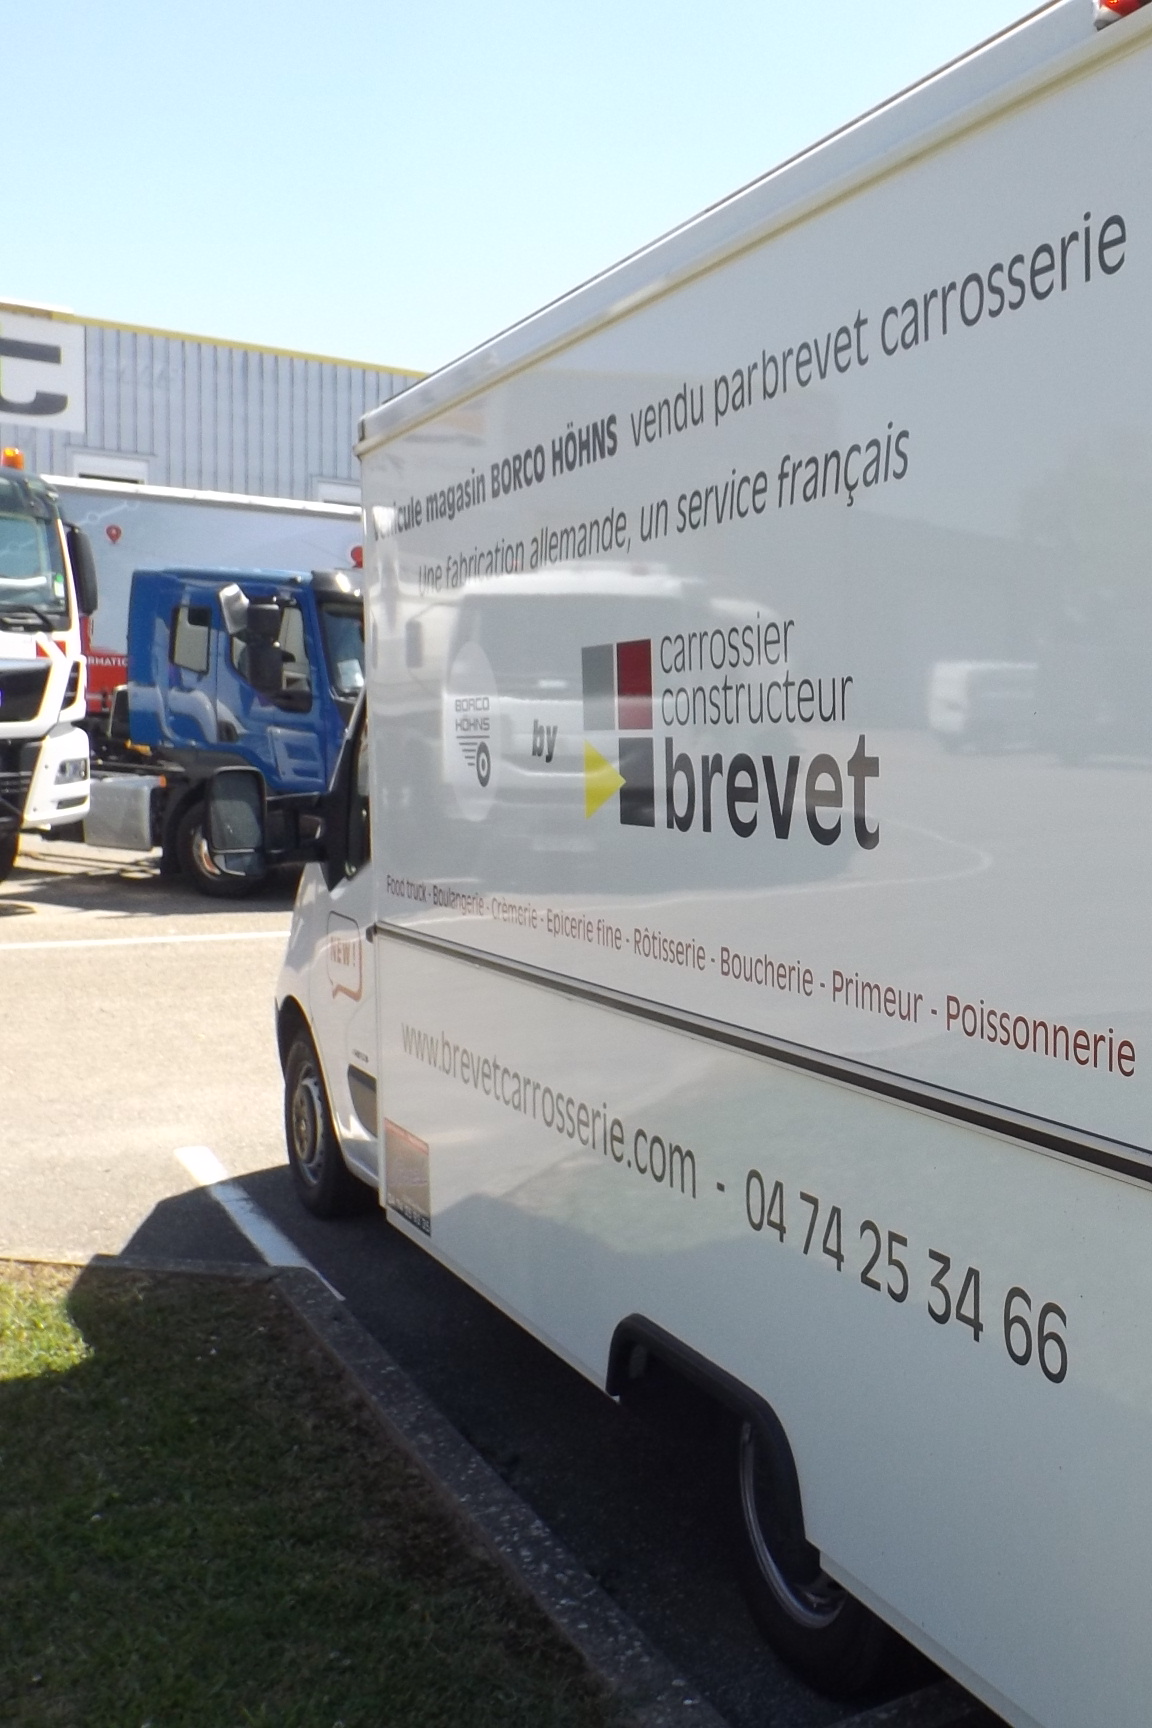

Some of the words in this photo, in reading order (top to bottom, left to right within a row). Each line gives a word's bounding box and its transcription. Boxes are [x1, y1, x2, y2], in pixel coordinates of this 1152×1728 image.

[372, 496, 423, 541] icule
[426, 468, 486, 523] magasin
[490, 444, 546, 499] BORCO
[551, 413, 618, 478] HÖHNS
[631, 382, 704, 447] vendu
[880, 211, 1127, 357] carrosserie
[418, 562, 443, 597] Une
[446, 536, 525, 591] fabrication
[529, 506, 632, 573] allemande,
[640, 499, 669, 542] un
[676, 468, 768, 533] service
[777, 421, 910, 507] français
[660, 612, 795, 674] carrossier
[660, 670, 854, 726] constructeur
[455, 697, 490, 712] BORCO
[532, 718, 558, 763] by
[665, 734, 880, 850] brevet
[386, 875, 404, 896] Food
[406, 879, 427, 902] truck
[433, 884, 485, 916] Boulangerie
[491, 896, 538, 929] Crèmerie
[547, 908, 593, 943] Epicerie
[597, 918, 622, 950] fine
[634, 927, 706, 971] Rôtisserie
[720, 946, 814, 997] Boucherie
[832, 970, 923, 1023] Primeur
[946, 995, 1136, 1077] Poissonnerie
[401, 1021, 697, 1200] www.brevetcarrosserie.com
[746, 1168, 787, 1243] 04
[800, 1191, 845, 1272] 74
[860, 1219, 909, 1303] 25
[928, 1248, 984, 1343] 34
[1003, 1286, 1068, 1384] 66
